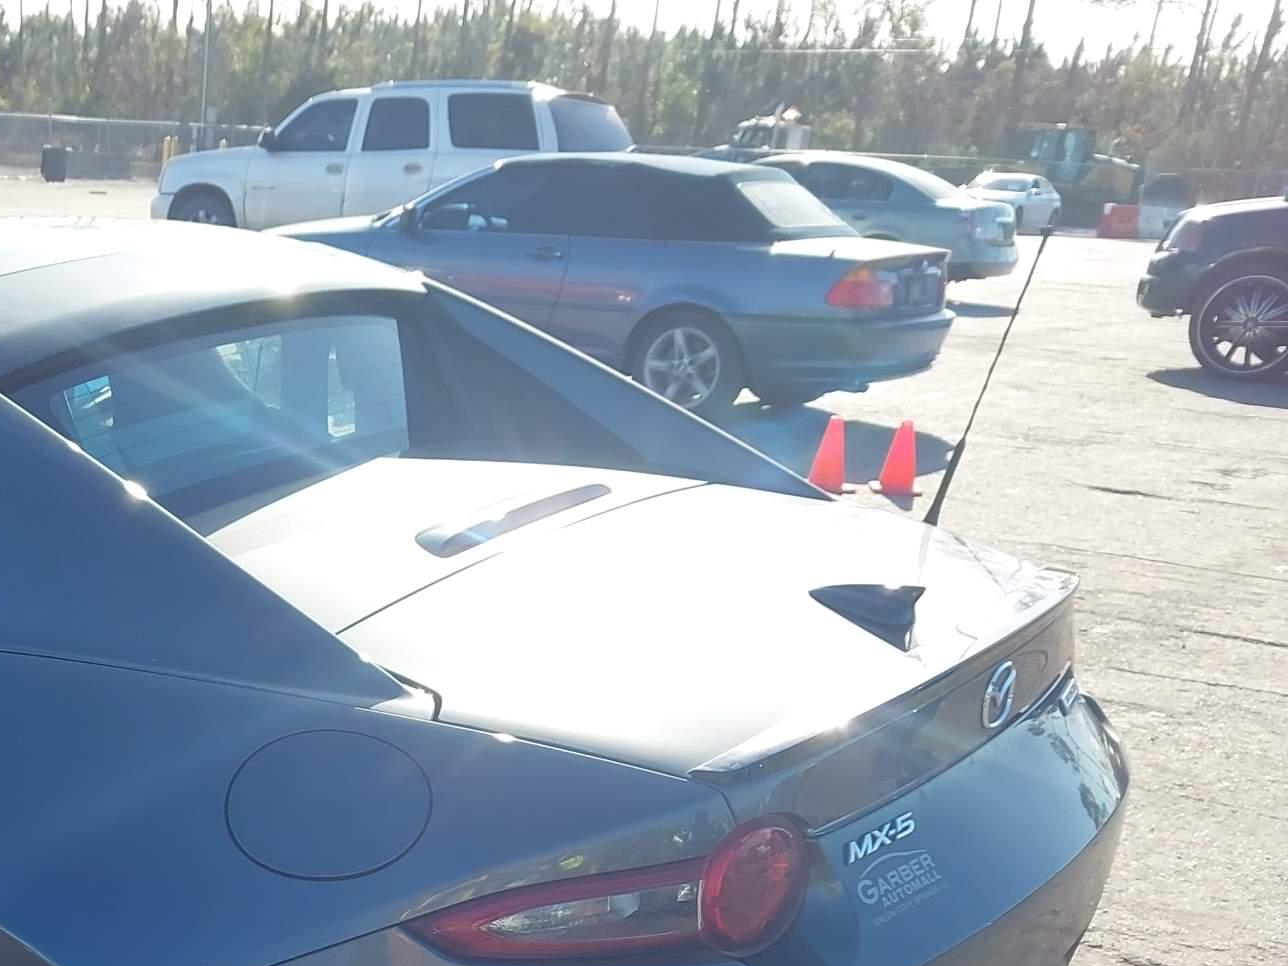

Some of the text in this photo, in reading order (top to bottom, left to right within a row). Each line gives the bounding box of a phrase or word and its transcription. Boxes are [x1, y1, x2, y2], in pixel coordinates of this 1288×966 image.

[848, 811, 915, 864] MX-5
[857, 854, 936, 904] GARBER
[881, 869, 942, 908] AUTOMALL
